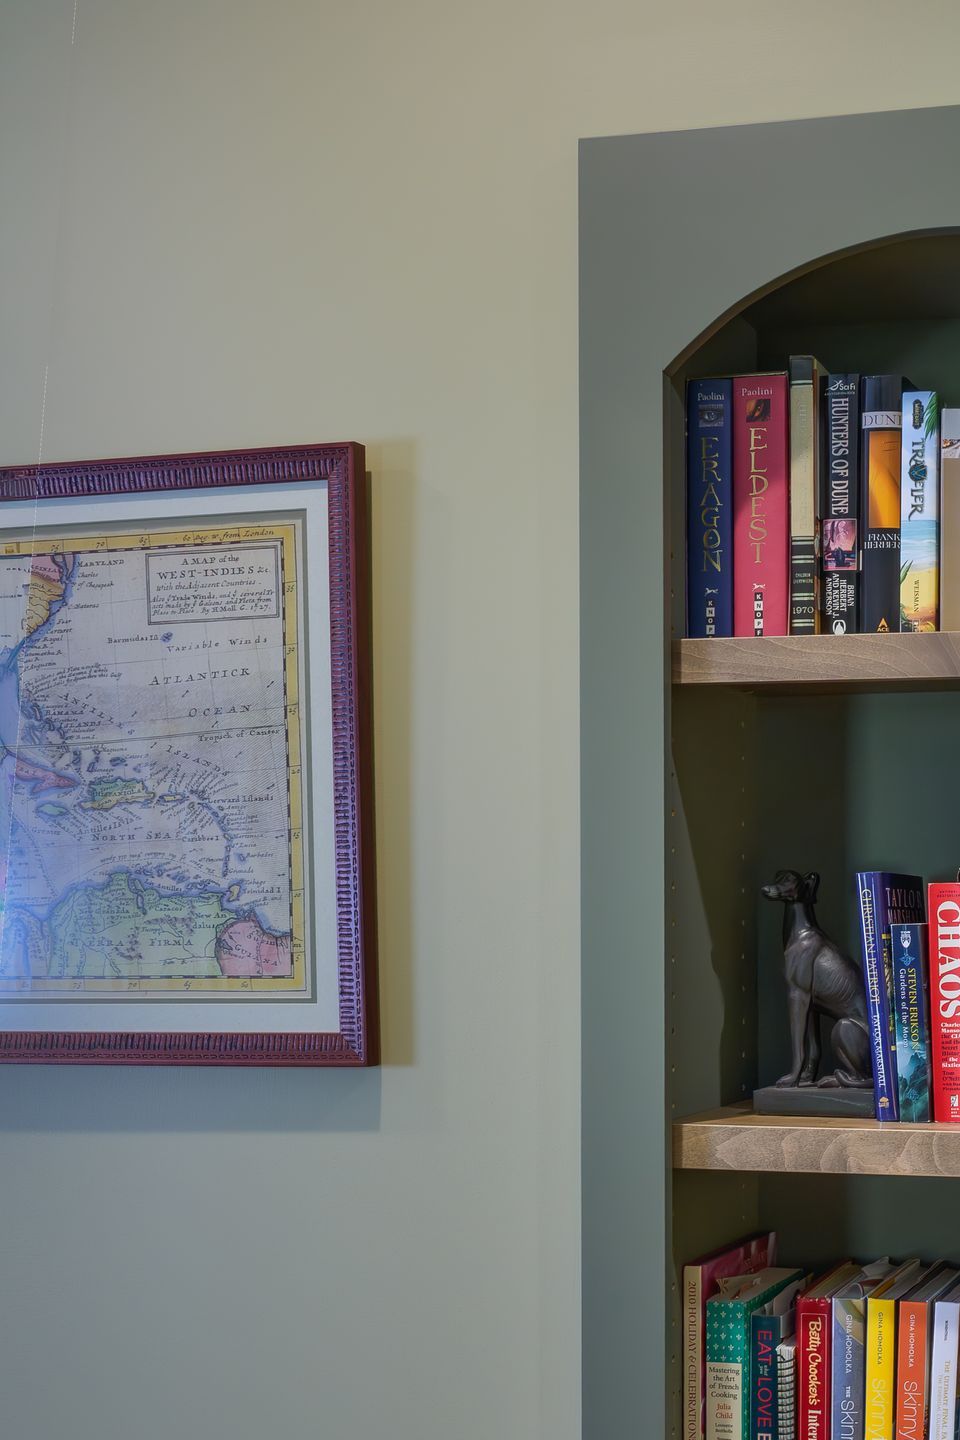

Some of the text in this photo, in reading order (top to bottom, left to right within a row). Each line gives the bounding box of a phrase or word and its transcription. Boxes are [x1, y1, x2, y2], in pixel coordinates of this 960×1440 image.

[697, 392, 725, 402] Paolini
[741, 387, 774, 397] Paolini
[831, 397, 849, 457] HUNTERS
[831, 459, 849, 477] OF
[748, 427, 769, 565] ELDEST
[831, 480, 849, 516] DUNE
[700, 436, 723, 574] ERAGON
[77, 558, 125, 568] MARYLAND
[191, 556, 216, 566] MAP
[218, 556, 227, 564] of
[157, 565, 254, 581] WEST-INDIES
[825, 576, 833, 616] ANDERSON
[832, 572, 841, 613] AND KEVIN
[840, 579, 848, 613] HERBERT
[847, 584, 855, 608] BRIAN
[793, 605, 814, 615] 1970
[228, 636, 268, 647] Winds
[148, 668, 250, 687] ATLANTICK
[187, 703, 252, 718] OCEAN
[236, 731, 246, 739] of
[92, 832, 172, 842] NORTH SEA
[149, 938, 194, 947] FIRMA
[861, 888, 880, 1005] CHRISTIAN PATRIOT
[900, 968, 909, 1000] Gardens
[901, 1002, 909, 1010] of
[907, 967, 920, 1051] STEVEN ERIKSON
[688, 1280, 697, 1305] 2010
[688, 1306, 697, 1353] HOLIDAY
[806, 1317, 822, 1351] Betty
[757, 1329, 773, 1365] EAT
[688, 1355, 697, 1363] &
[708, 1366, 740, 1375] Mastering
[713, 1375, 724, 1383] the
[807, 1352, 822, 1405] Crocker's
[711, 1391, 738, 1400] Cooking
[718, 1383, 739, 1391] French
[716, 1402, 731, 1411] Julia
[757, 1376, 773, 1428] LOVE
[715, 1411, 733, 1419] Child
